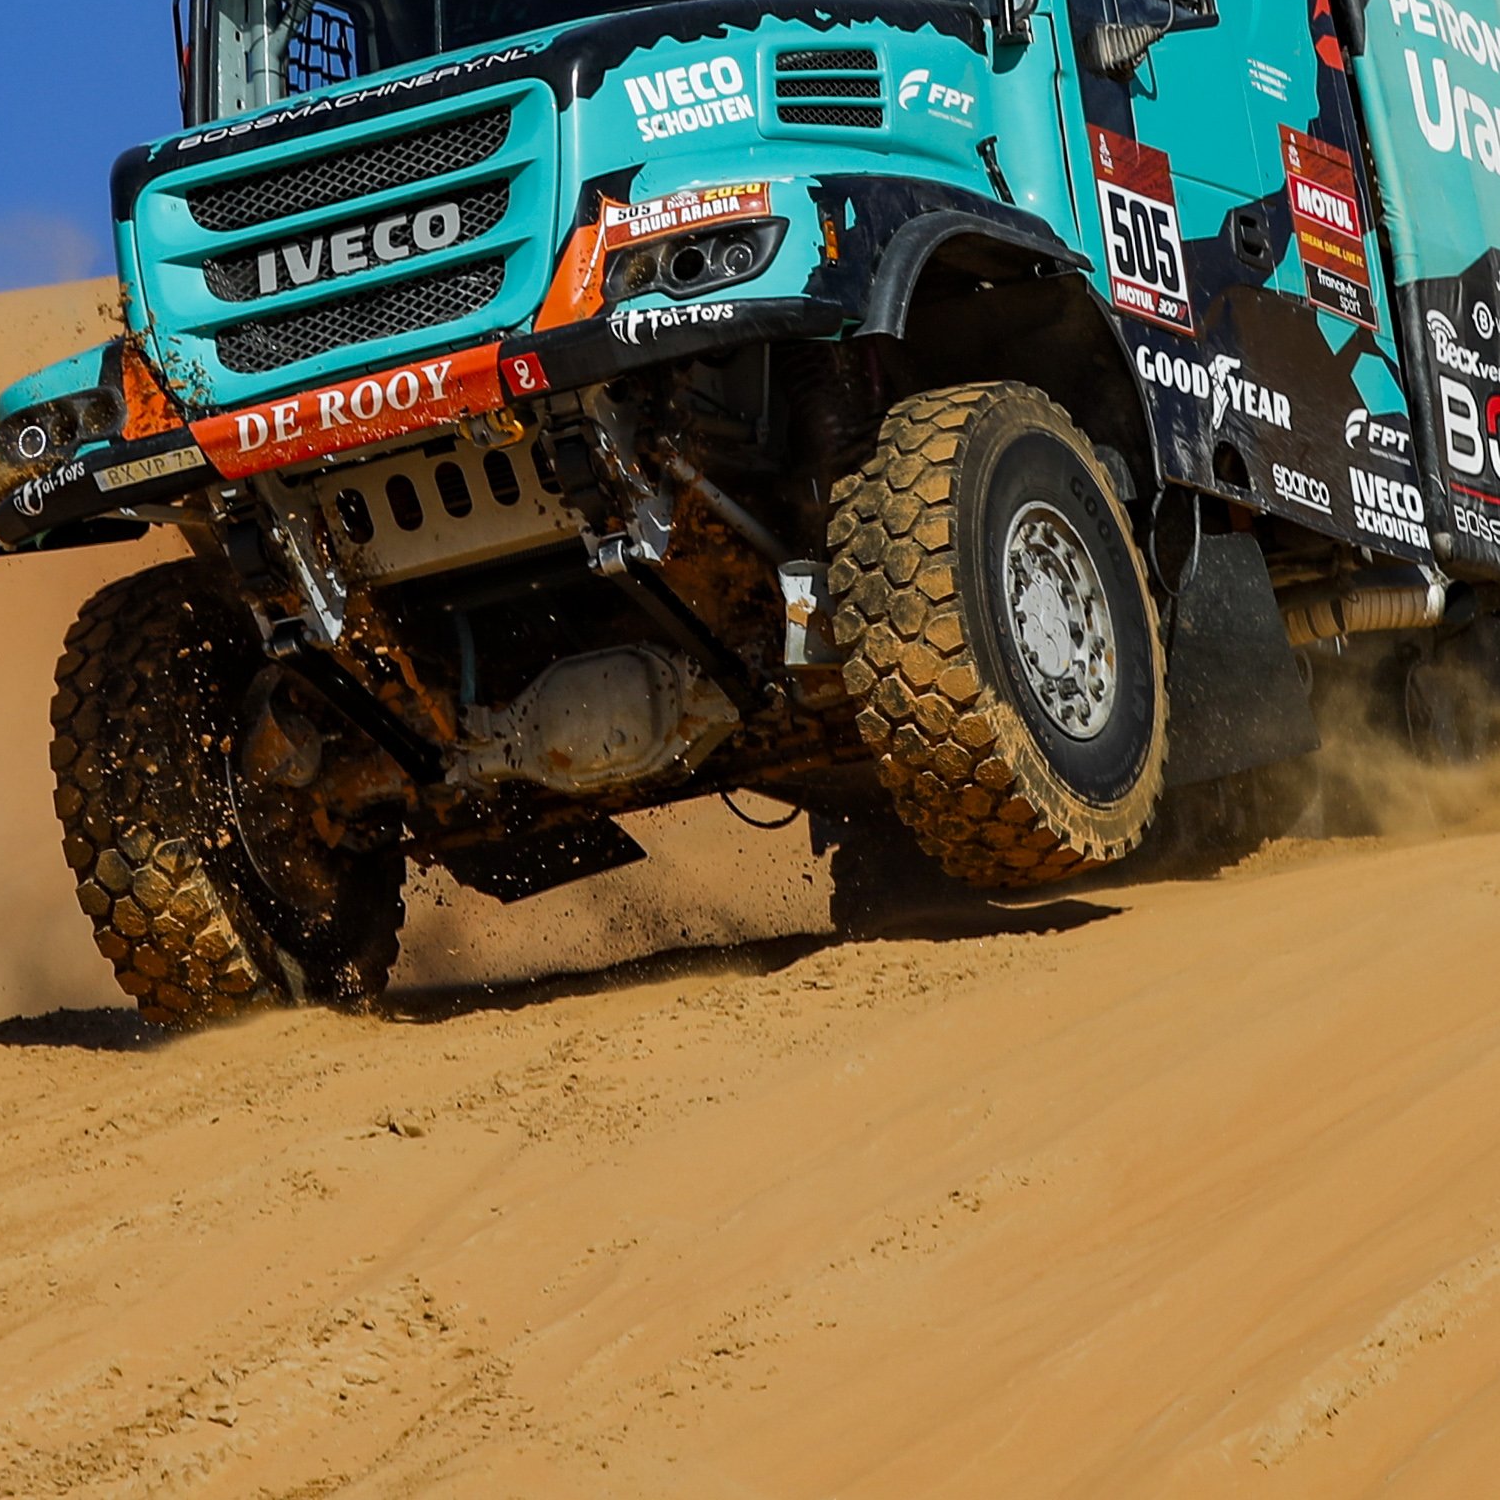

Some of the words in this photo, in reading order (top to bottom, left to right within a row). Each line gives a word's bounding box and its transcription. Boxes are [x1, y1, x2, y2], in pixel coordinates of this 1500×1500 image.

[177, 48, 528, 151] BOSSMACHINERY.NL
[623, 56, 744, 116] IVECO
[927, 83, 975, 115] FPT
[637, 94, 755, 142] SCHOUTEN
[617, 203, 651, 221] 505
[703, 183, 761, 201] 2020
[1297, 181, 1354, 232] MOTUL
[629, 211, 678, 237] SAUDI
[681, 196, 741, 223] ARABIA
[258, 202, 460, 294] IVECO
[1107, 190, 1180, 293] 505
[1116, 282, 1156, 313] MOTUL
[1340, 293, 1362, 316] sport
[235, 401, 303, 453] DE
[317, 360, 453, 431] ROOY
[1368, 421, 1409, 452] FPT
[108, 466, 136, 486] BX
[139, 457, 167, 477] VP
[173, 450, 198, 468] 73
[1272, 463, 1331, 508] sparco
[1349, 466, 1425, 524] IVECO
[1354, 503, 1432, 551] SCHOUTEN
